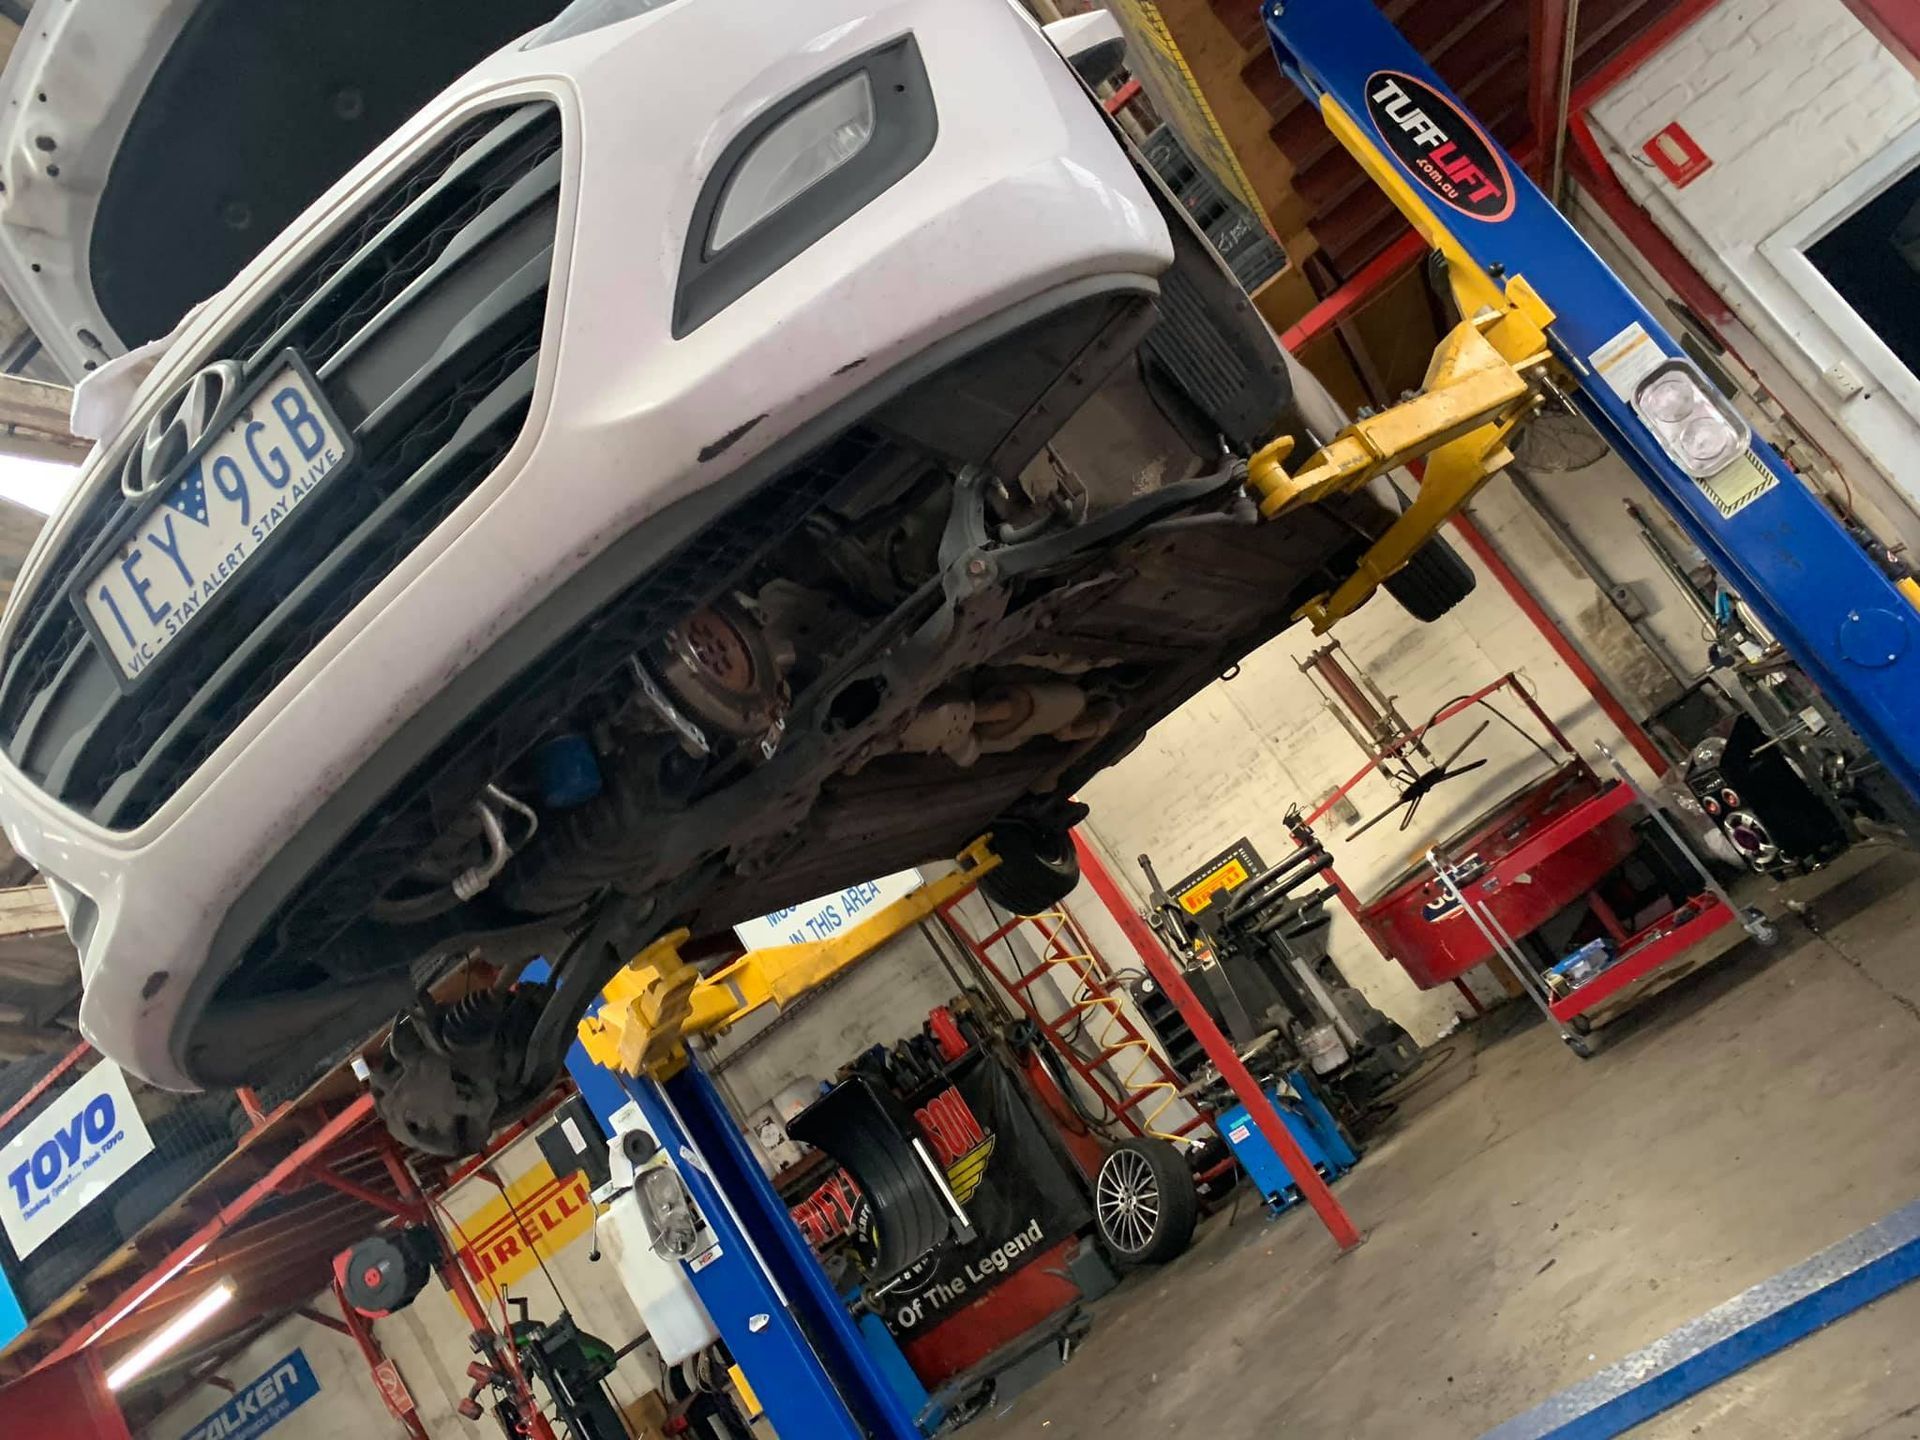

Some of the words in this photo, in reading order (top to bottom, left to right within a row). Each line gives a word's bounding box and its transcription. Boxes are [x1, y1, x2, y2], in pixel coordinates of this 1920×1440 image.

[98, 513, 195, 649] 1EY
[212, 387, 326, 527] 9GB
[128, 648, 154, 674] VIC
[164, 594, 201, 637] STAY
[203, 542, 247, 596] ALERT
[251, 498, 290, 543] STAY
[291, 447, 338, 497] ALIVE
[806, 904, 842, 940] THIS
[841, 880, 882, 917] AREA
[7, 1092, 116, 1210] TOYO
[101, 1130, 125, 1154] TOYO
[897, 1297, 924, 1329] Of
[923, 1275, 966, 1309] The
[964, 1218, 1045, 1284] Legend
